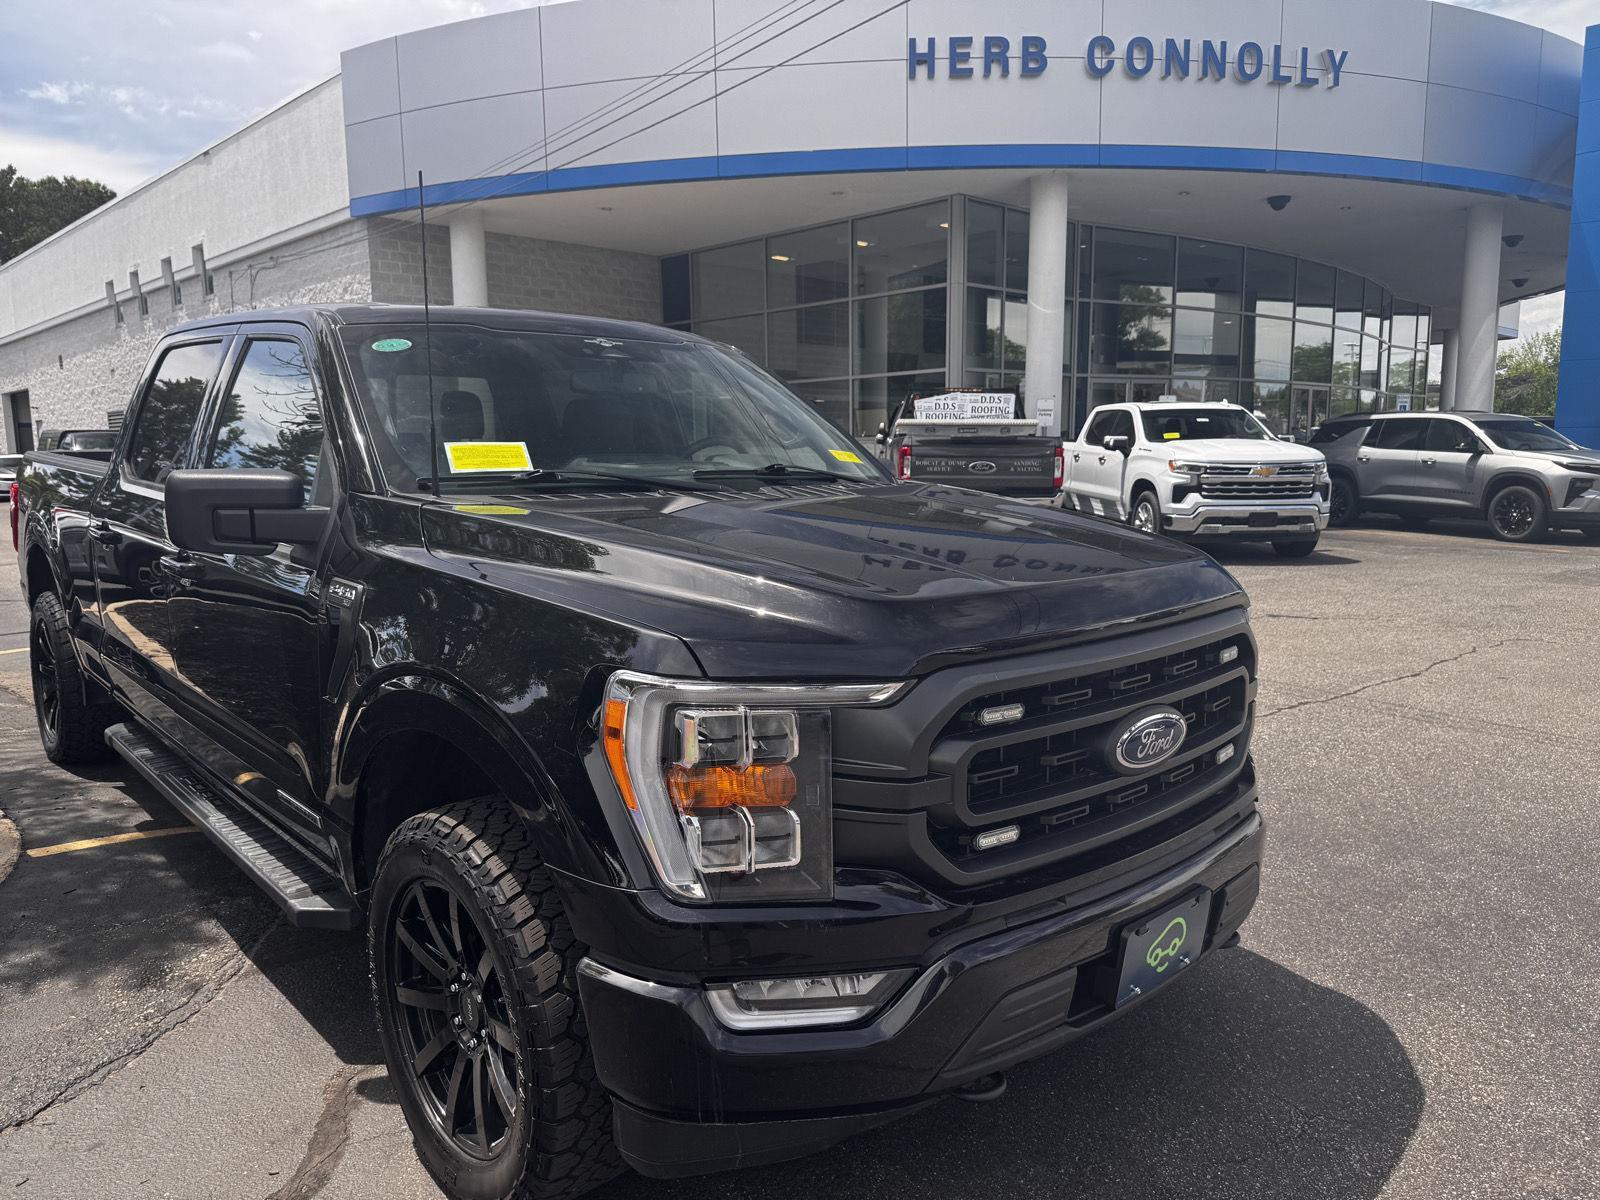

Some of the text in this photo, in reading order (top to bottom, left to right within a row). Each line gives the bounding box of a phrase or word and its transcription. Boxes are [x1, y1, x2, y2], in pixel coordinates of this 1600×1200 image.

[908, 35, 1349, 88] HERB CONNOLLY
[925, 412, 965, 420] ROOFING
[971, 405, 1010, 415] ROOFING
[1137, 725, 1174, 759] Ford
